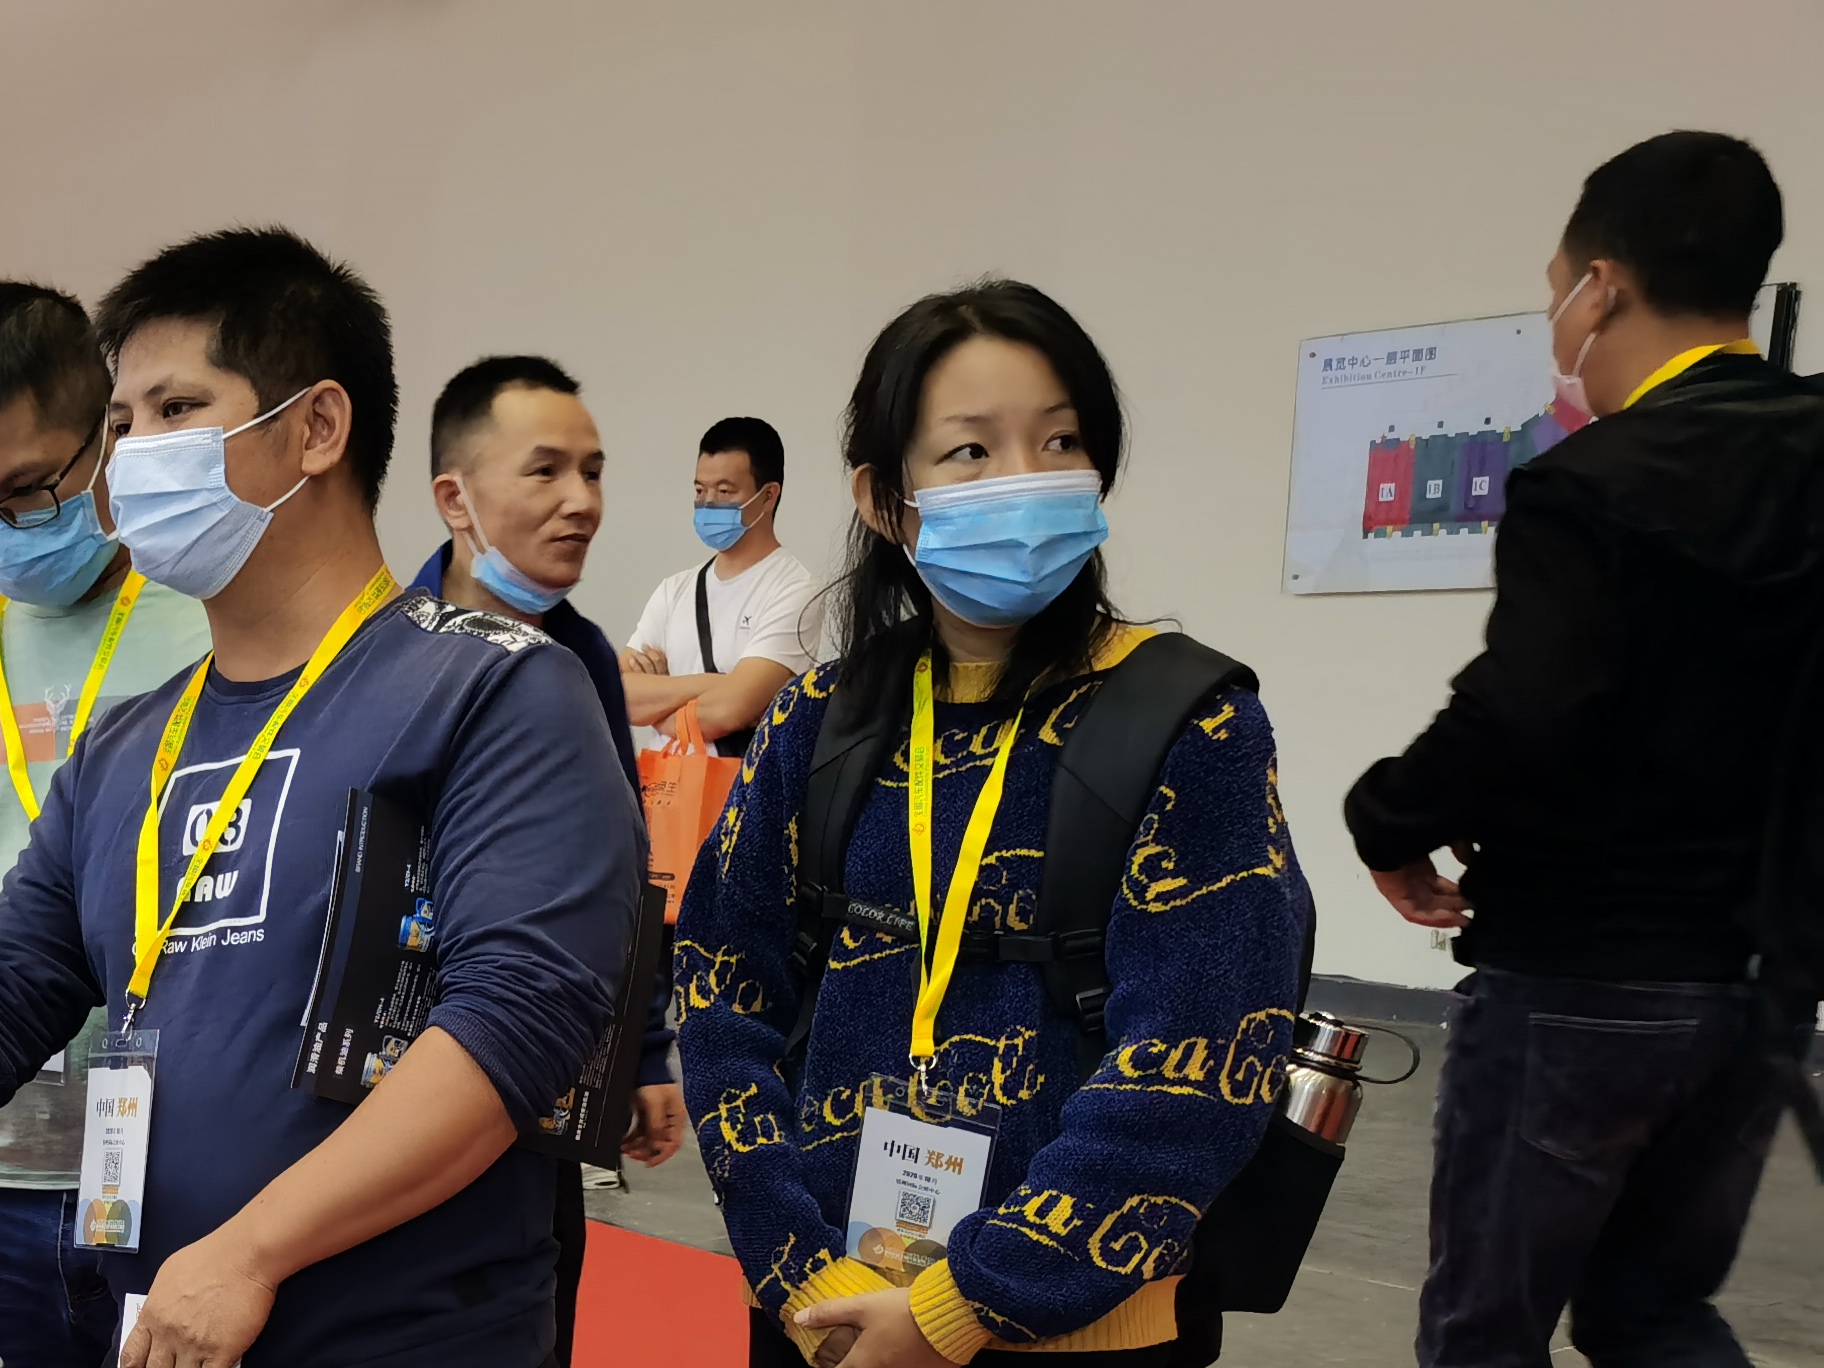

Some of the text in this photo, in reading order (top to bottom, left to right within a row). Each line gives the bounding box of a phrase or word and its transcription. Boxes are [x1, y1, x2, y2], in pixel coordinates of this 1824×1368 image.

[1321, 373, 1372, 386] Exhibition
[190, 932, 217, 953] Klein
[221, 929, 265, 946] Jeans
[306, 1022, 328, 1075] 润滑油产品
[96, 1097, 139, 1119] 中国 郑州
[883, 1140, 964, 1175] 中国 郑州
